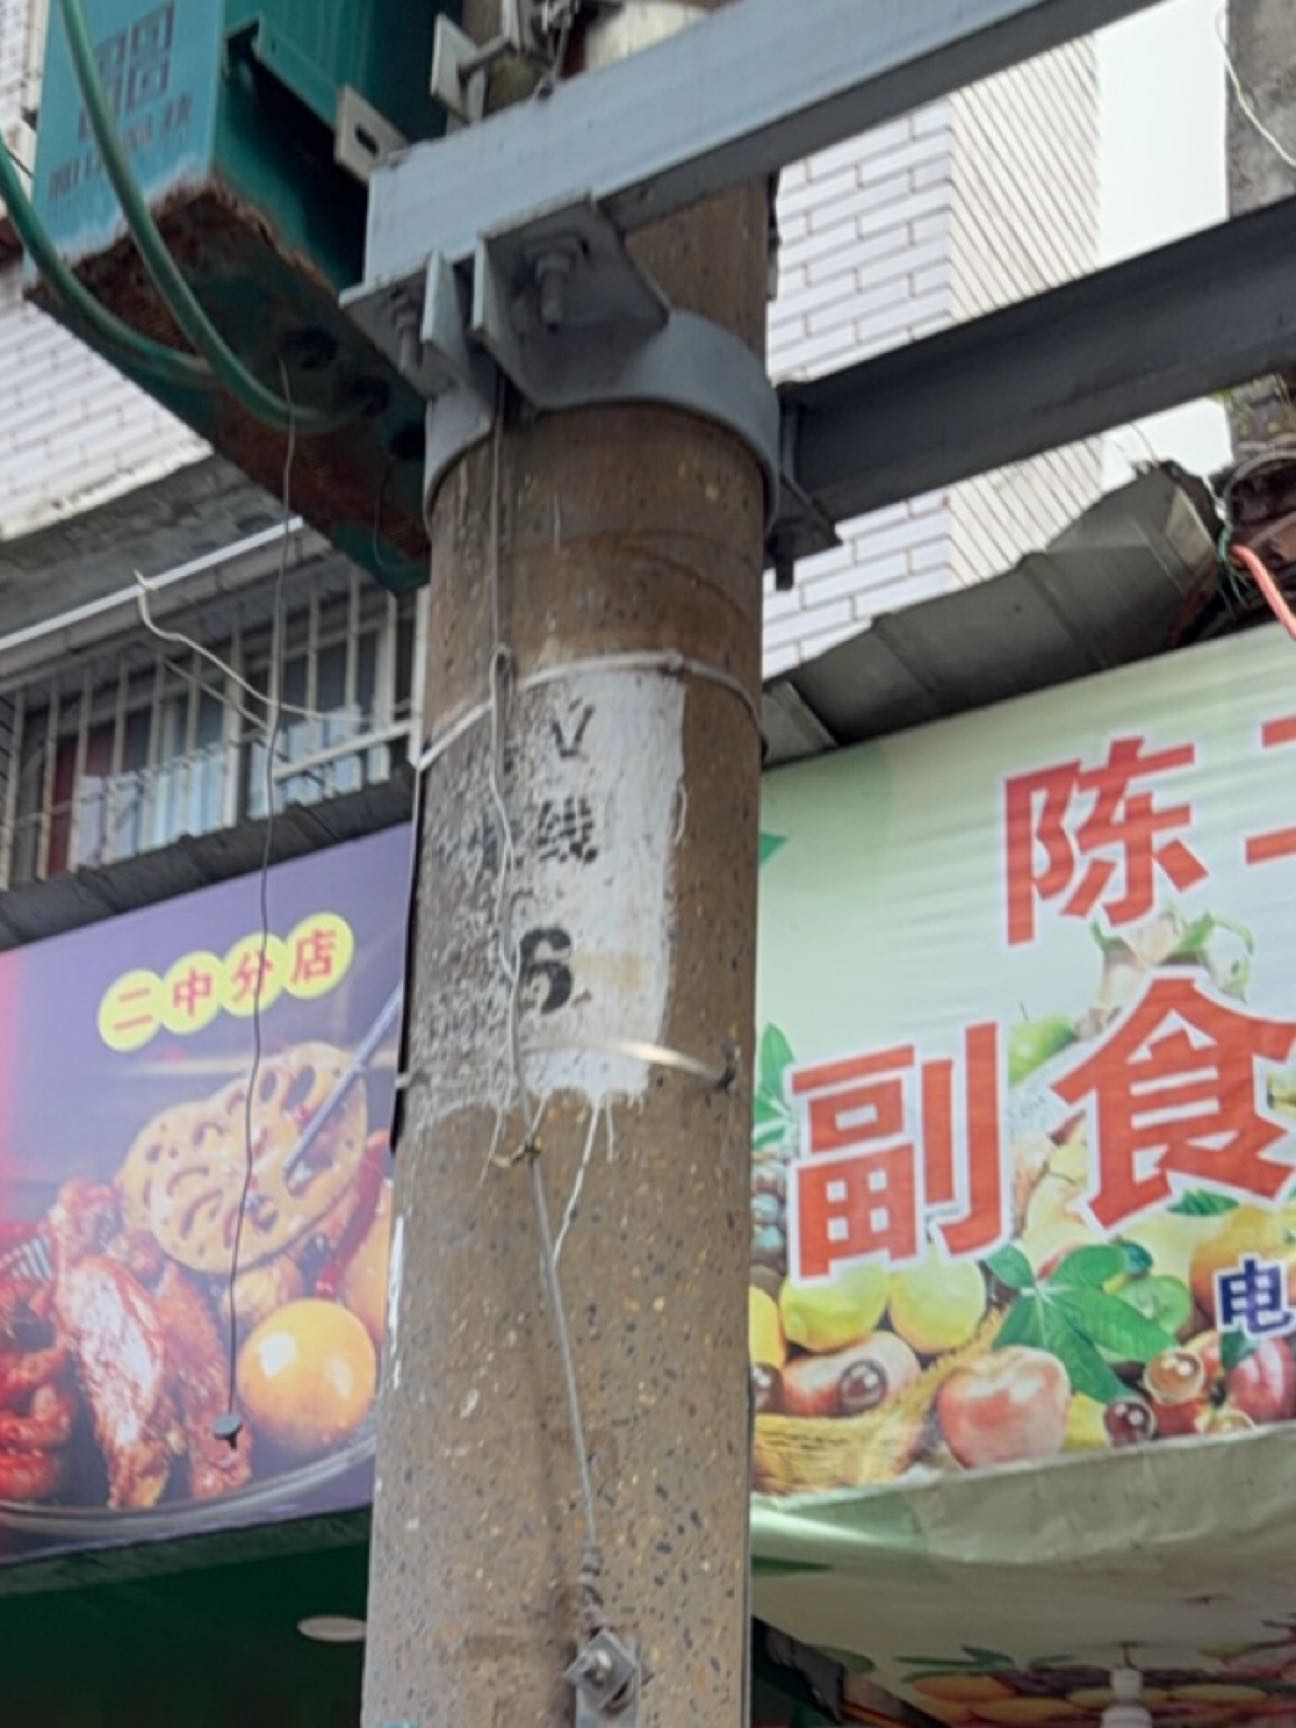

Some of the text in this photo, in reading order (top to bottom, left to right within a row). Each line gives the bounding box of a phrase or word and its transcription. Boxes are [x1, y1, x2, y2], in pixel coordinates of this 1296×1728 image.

[113, 928, 337, 1032] 二中分店
[791, 976, 1296, 1280] 副食
[1218, 1258, 1292, 1333] 电
